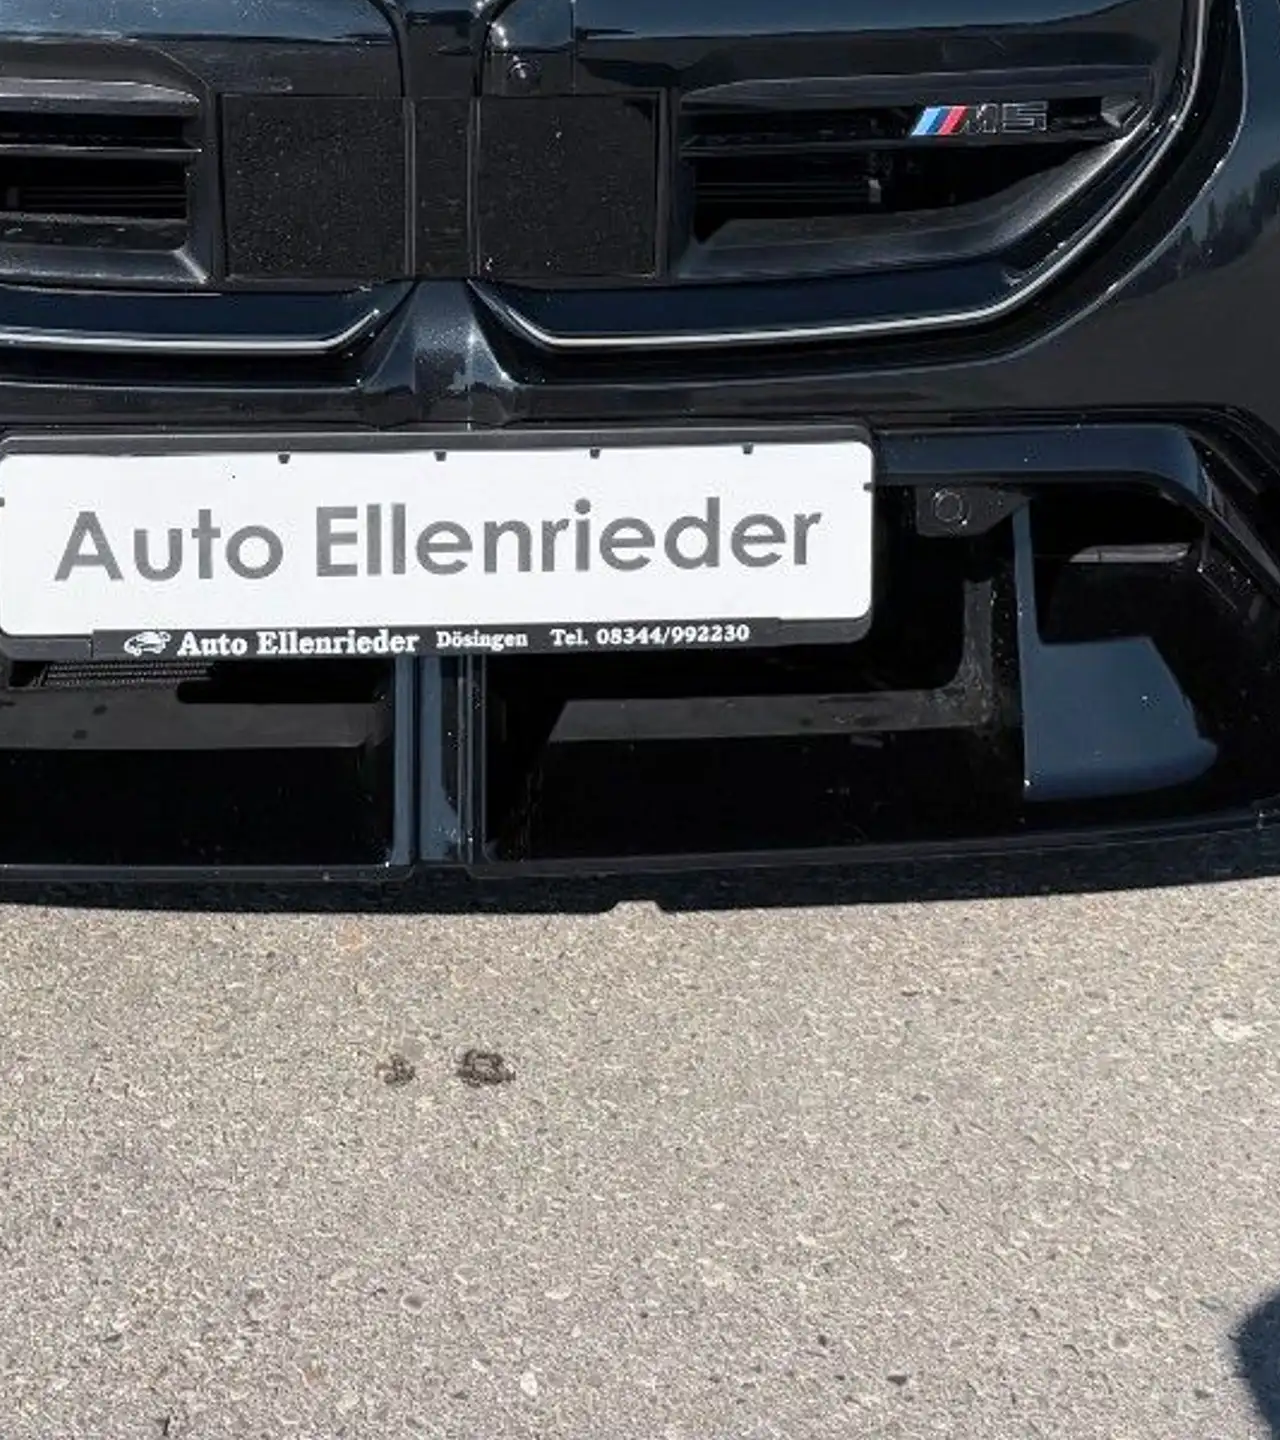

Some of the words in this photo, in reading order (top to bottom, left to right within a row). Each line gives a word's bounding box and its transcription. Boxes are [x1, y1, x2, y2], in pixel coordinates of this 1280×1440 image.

[54, 508, 284, 582] Auto
[315, 496, 823, 578] Ellenrieder
[176, 631, 248, 656] Auto
[256, 629, 421, 655] Ellenrieder
[436, 630, 528, 652] Dösingen
[549, 628, 590, 647] Tel.
[596, 624, 751, 648] 08344/992230
